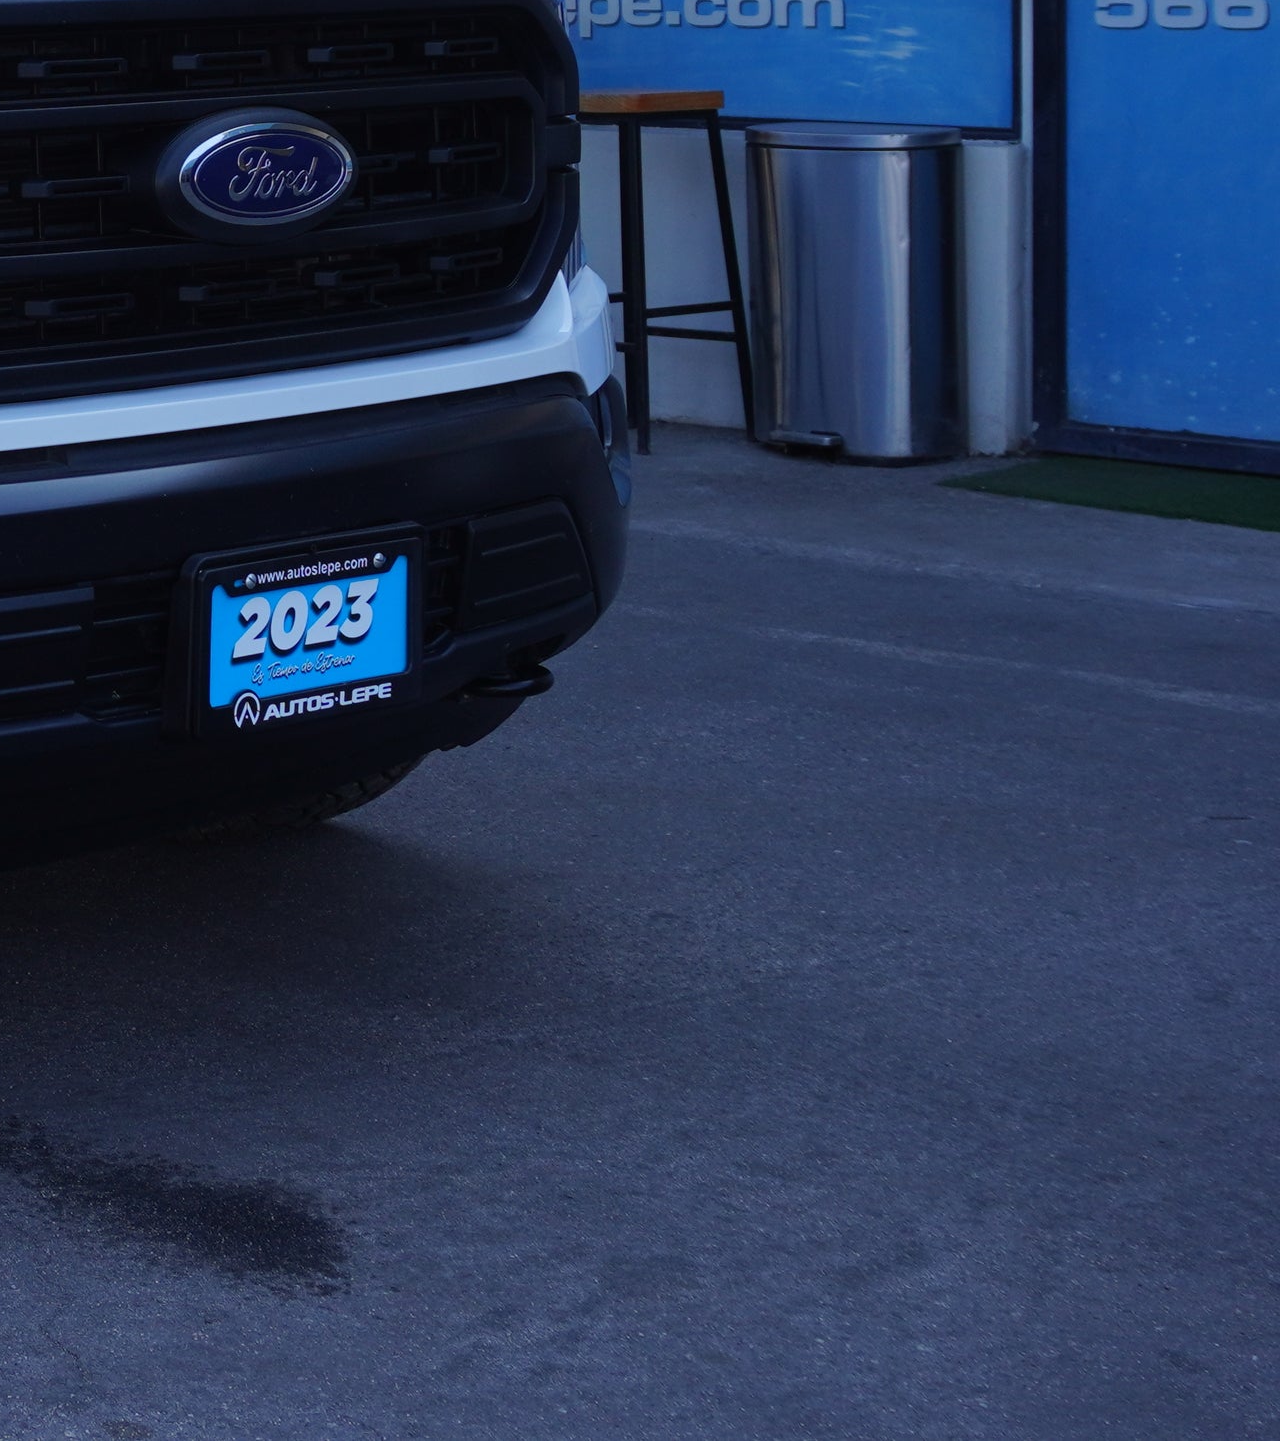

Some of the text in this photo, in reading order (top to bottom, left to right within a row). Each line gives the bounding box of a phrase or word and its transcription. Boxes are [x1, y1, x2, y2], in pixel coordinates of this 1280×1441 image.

[228, 145, 319, 203] Ford
[257, 557, 368, 585] www.autoslepe.com
[233, 577, 380, 660] 2023
[251, 651, 356, 685] Es Tiempo de Estrenar
